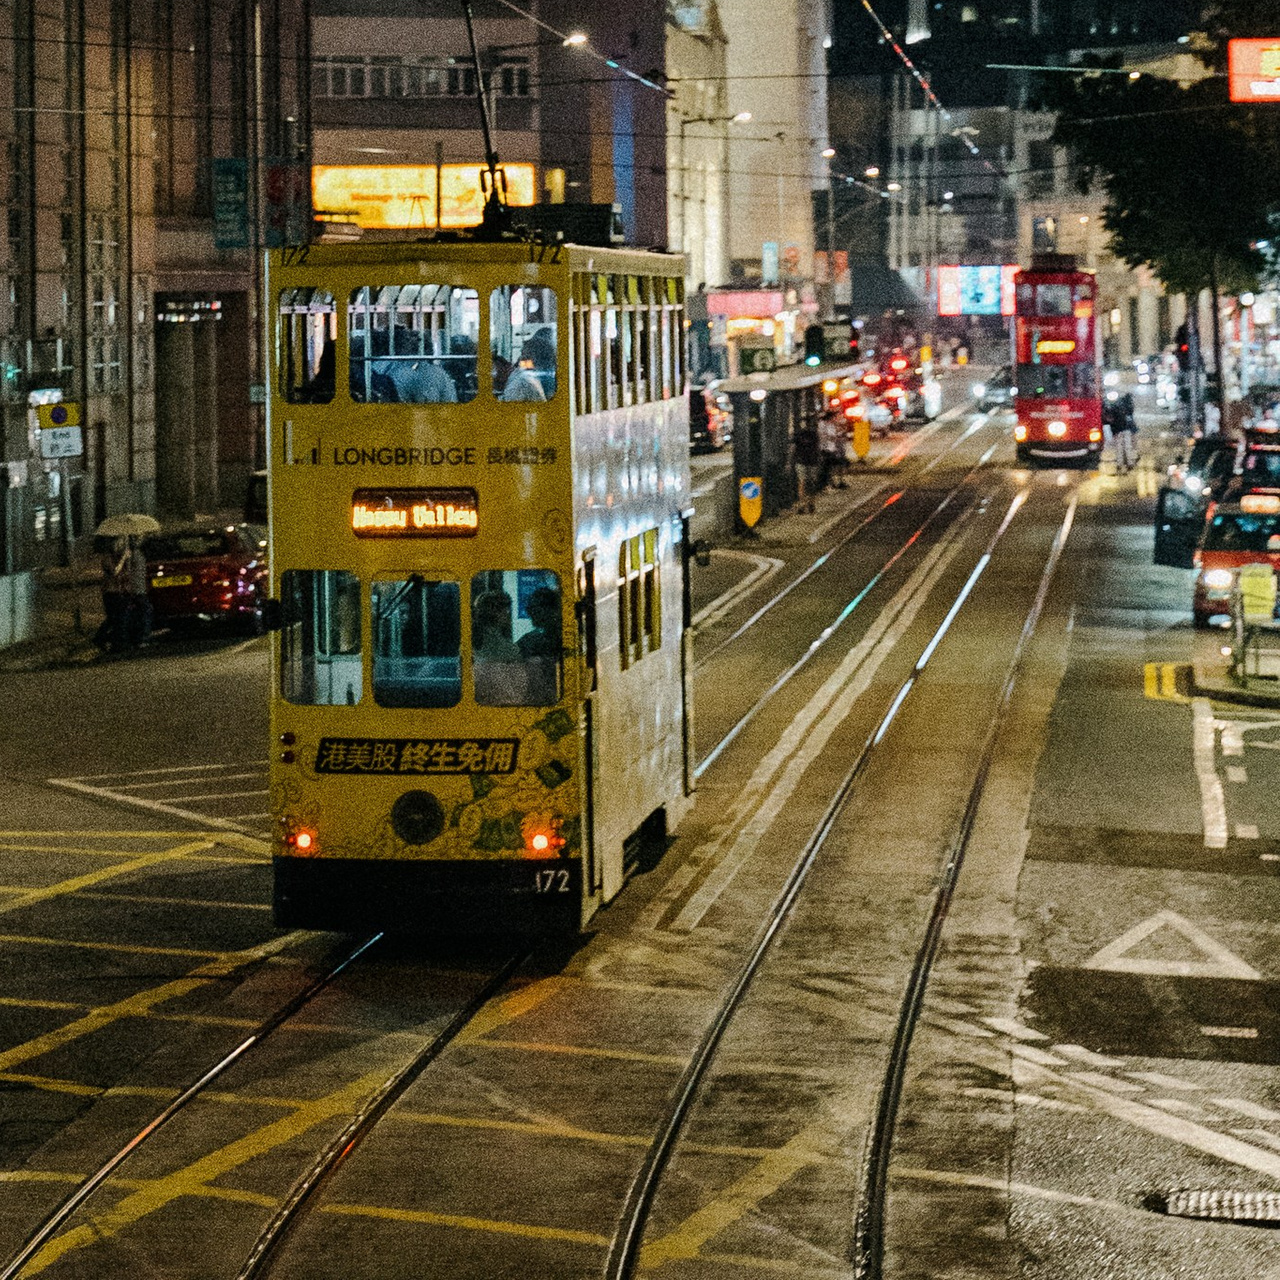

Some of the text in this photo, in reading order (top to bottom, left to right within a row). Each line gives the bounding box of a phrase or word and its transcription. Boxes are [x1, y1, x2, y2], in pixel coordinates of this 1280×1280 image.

[333, 446, 477, 466] LONGBRIDGE
[412, 505, 478, 528] Valley
[535, 868, 570, 893] 172
